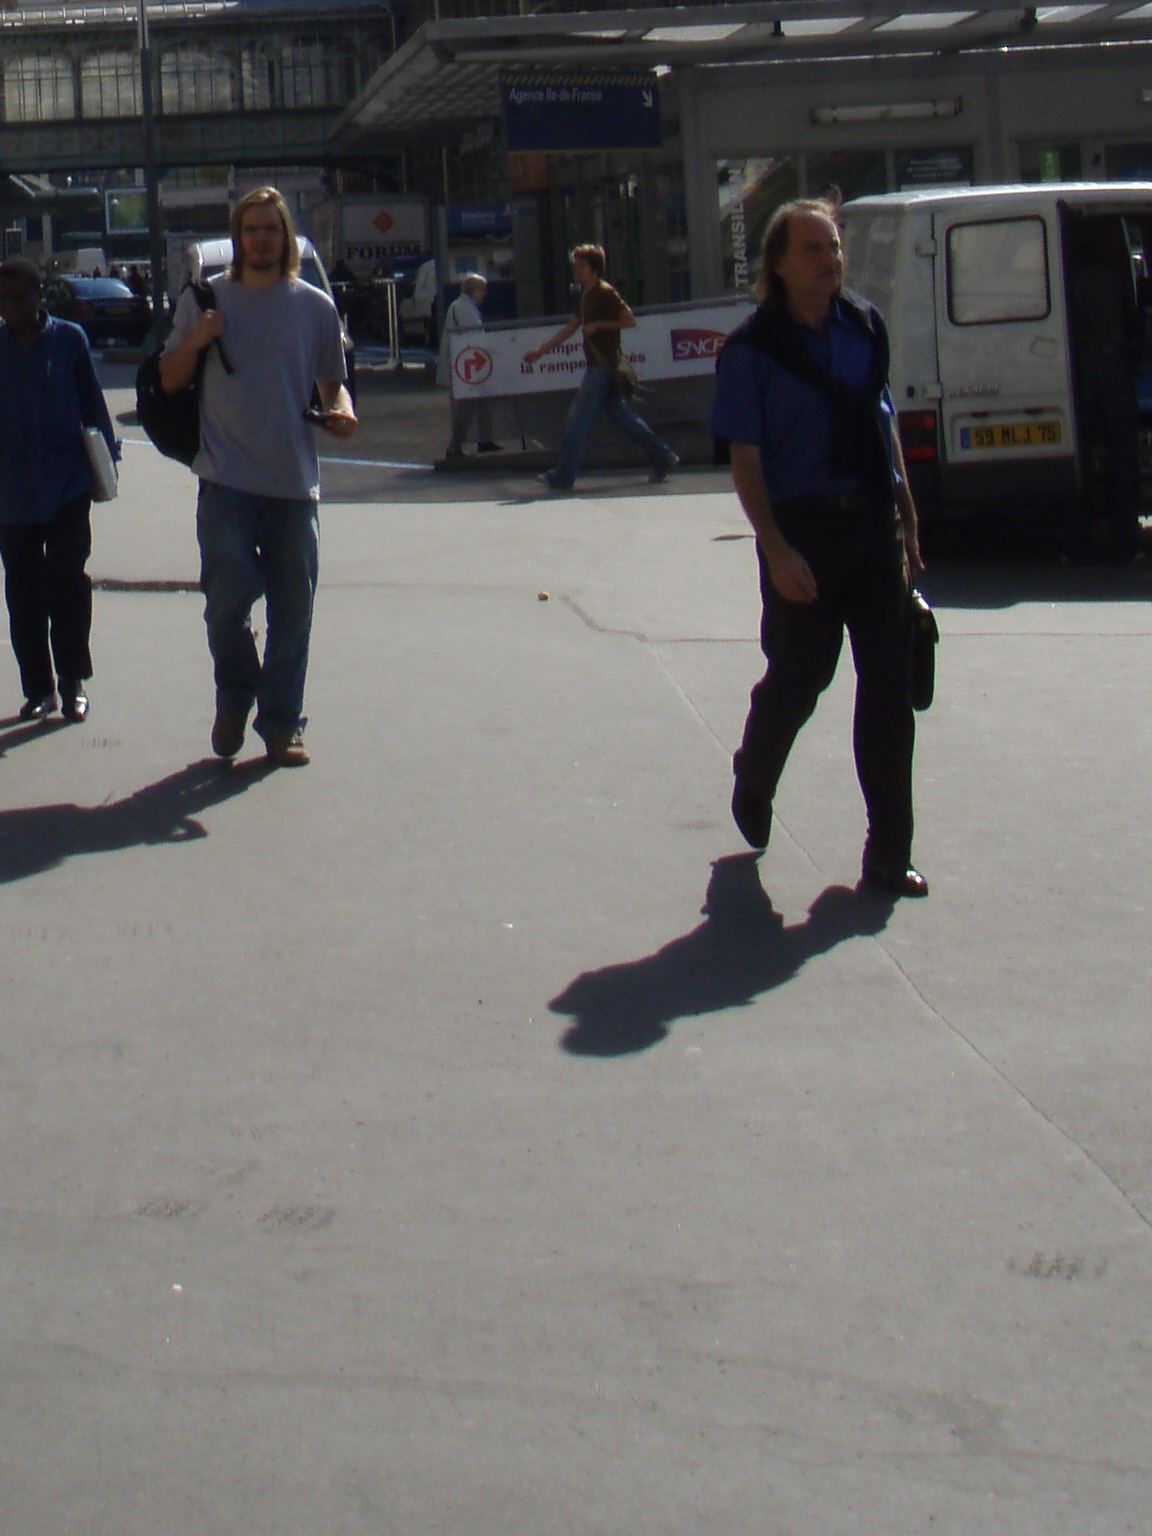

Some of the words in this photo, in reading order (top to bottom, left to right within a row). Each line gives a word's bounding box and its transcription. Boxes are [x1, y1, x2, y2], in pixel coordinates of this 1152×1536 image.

[346, 244, 420, 260] FORUM
[676, 337, 726, 358] SNCF
[520, 361, 534, 374] la
[539, 359, 586, 373] rampe
